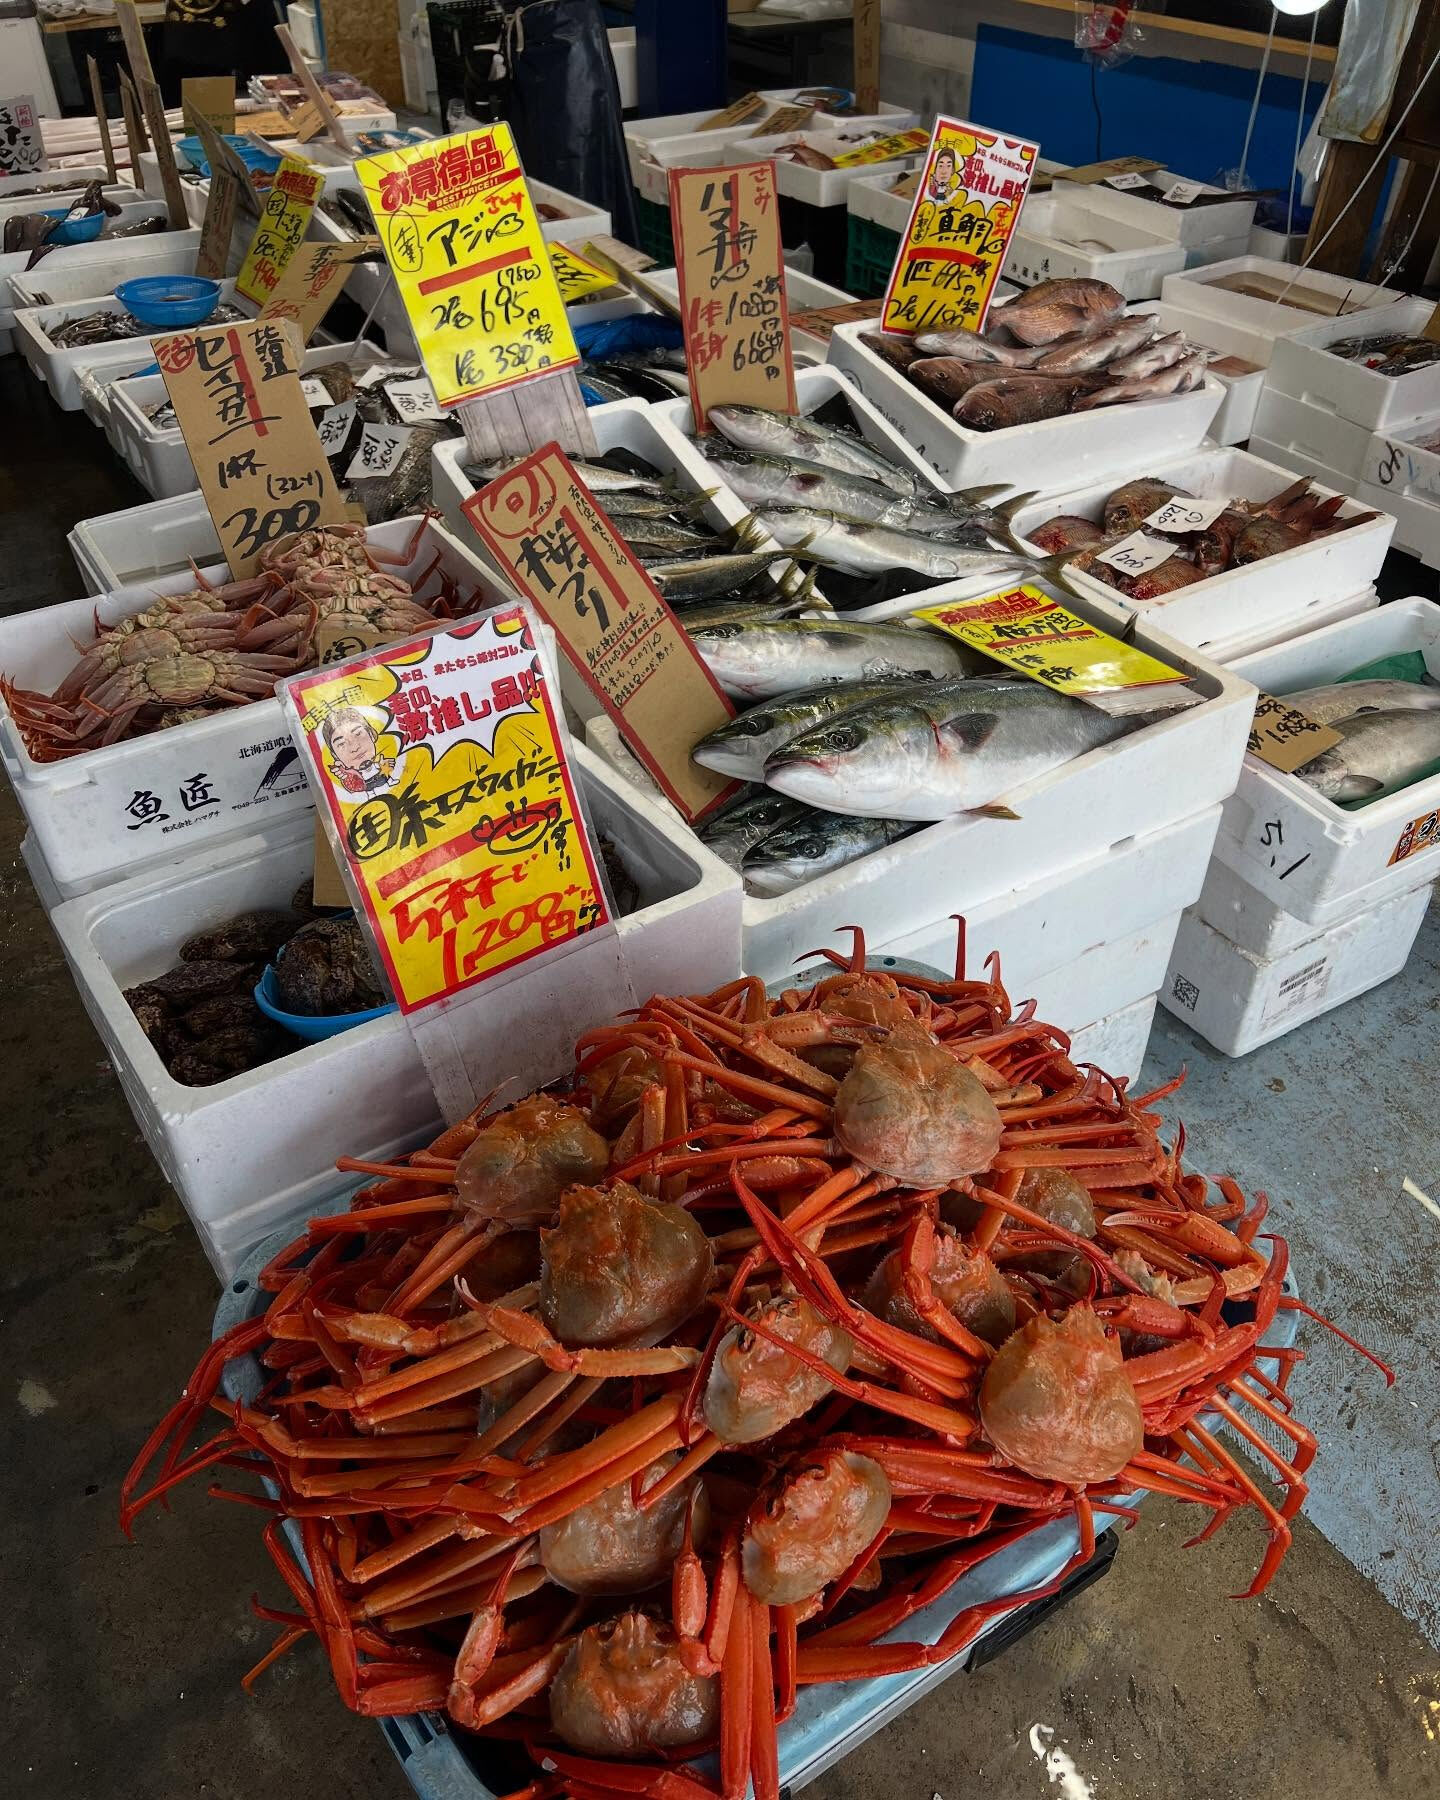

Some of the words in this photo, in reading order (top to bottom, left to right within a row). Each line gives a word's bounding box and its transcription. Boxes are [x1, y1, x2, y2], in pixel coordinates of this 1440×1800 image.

[379, 135, 505, 213] お買得品
[436, 191, 462, 208] BEST
[426, 212, 485, 267] アジ
[929, 206, 993, 255] 真鯛
[221, 500, 321, 560] 300
[398, 672, 541, 744] 激推し品!!
[161, 819, 193, 835] 株式会社
